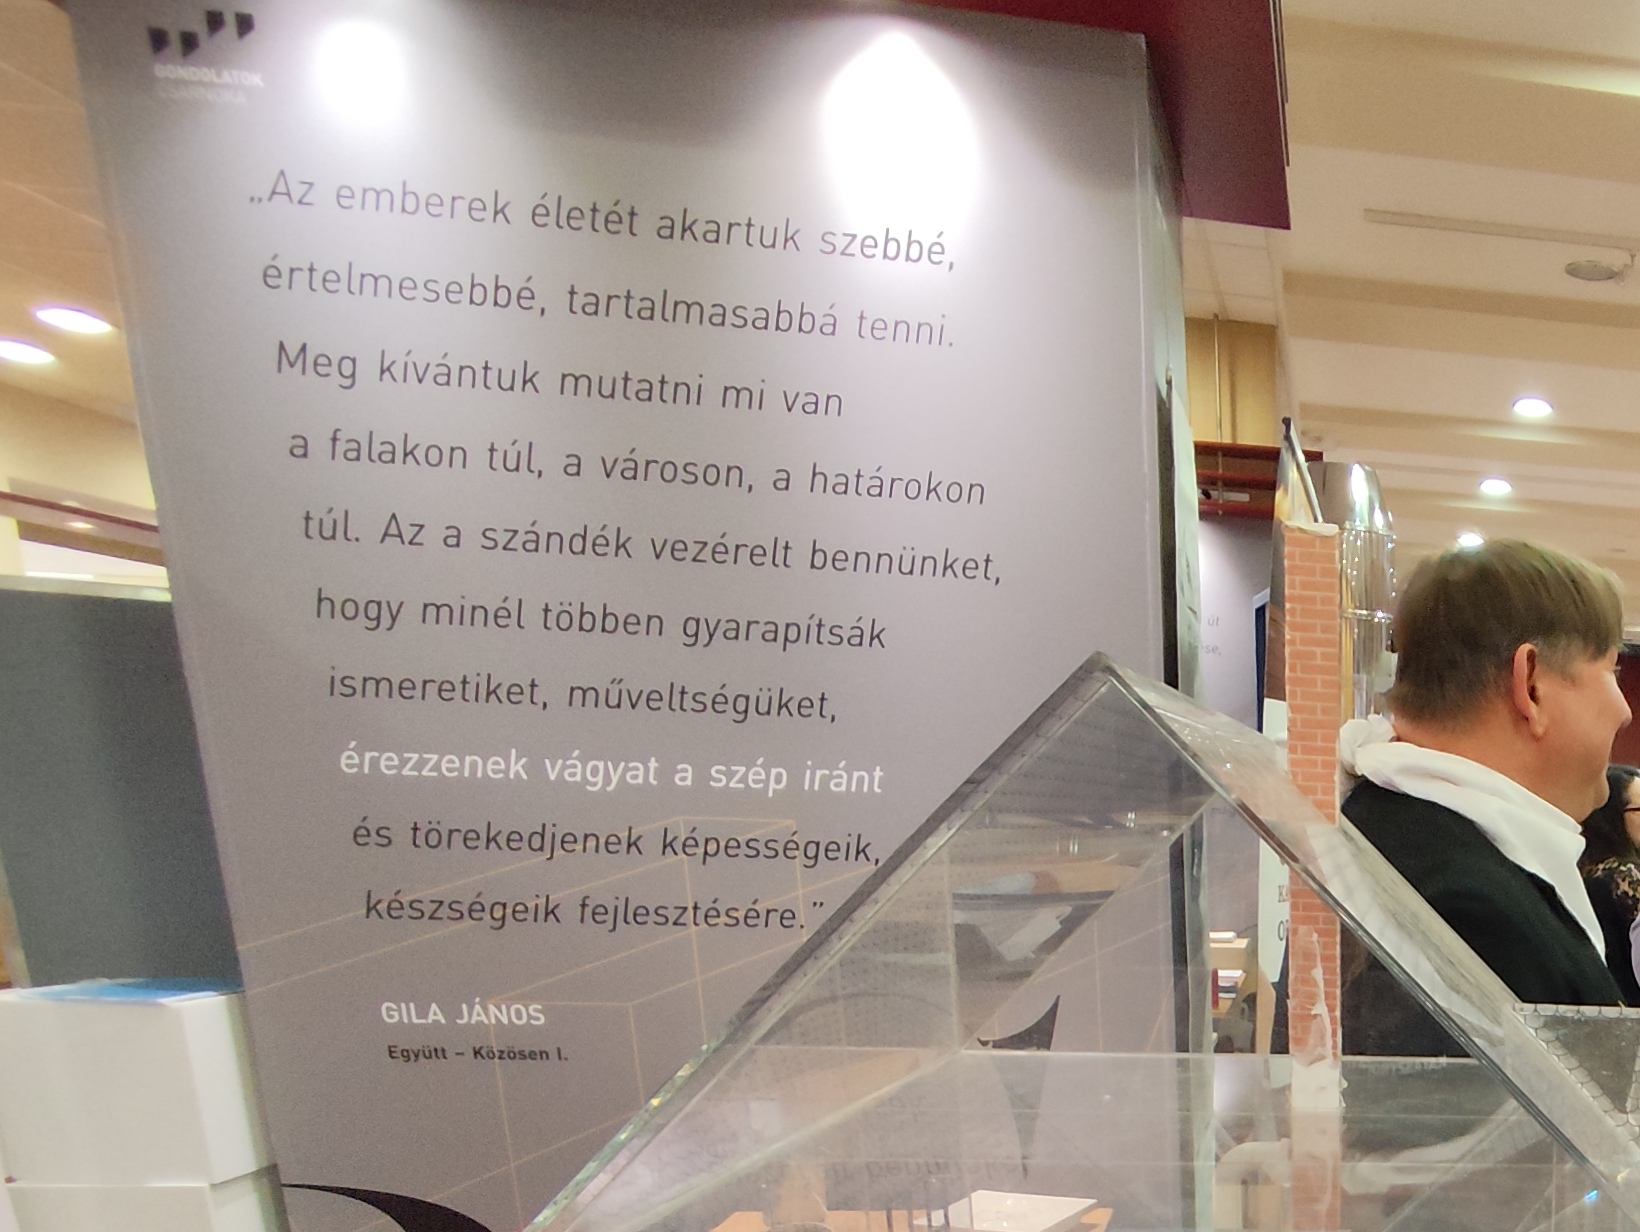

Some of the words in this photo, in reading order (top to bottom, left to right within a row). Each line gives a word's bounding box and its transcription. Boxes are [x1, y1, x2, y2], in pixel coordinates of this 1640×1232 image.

[154, 63, 265, 88] GONDOLATOK
[336, 181, 511, 225] emberek
[531, 193, 638, 237] életét
[656, 208, 800, 251] akartuk
[818, 225, 956, 274] szebbé,
[262, 254, 546, 317] értelmesebbé,
[568, 284, 837, 336] tartalmasabbá
[856, 310, 955, 348] tenni.
[277, 340, 357, 390] Meg
[379, 350, 539, 394] kívántuk
[560, 371, 703, 406] mutatni
[722, 379, 765, 410] mi
[783, 390, 842, 417] van
[289, 434, 309, 459] a
[330, 428, 467, 469] falakon
[488, 439, 543, 479] túl,
[563, 454, 582, 477] a
[601, 448, 753, 493] városon,
[772, 469, 791, 491] a
[810, 462, 985, 505] határokon
[303, 507, 360, 542] túl.
[380, 512, 425, 546] Az
[443, 525, 461, 548] a
[481, 520, 632, 558] szándék
[651, 532, 792, 568] vezérelt
[810, 539, 1000, 586] bennünket,
[316, 587, 404, 631] hogy
[421, 596, 524, 629] minél
[542, 602, 664, 636] többen
[683, 614, 885, 652] gyarapítsák
[329, 667, 548, 711] ismeretiket,
[568, 678, 836, 724] műveltségüket,
[340, 741, 527, 780] érezzenek
[545, 750, 659, 791] vágyat
[674, 764, 693, 786] a
[710, 757, 787, 797] szép
[804, 760, 883, 793] iránt
[352, 816, 393, 848] és
[411, 821, 643, 861] törekedjenek
[661, 827, 881, 868] képességeik,
[365, 890, 561, 931] készségeik
[381, 1002, 446, 1024] GILA
[456, 997, 545, 1025] JÁNOS
[387, 1045, 448, 1063] Együtt
[472, 1046, 550, 1061] Közösen
